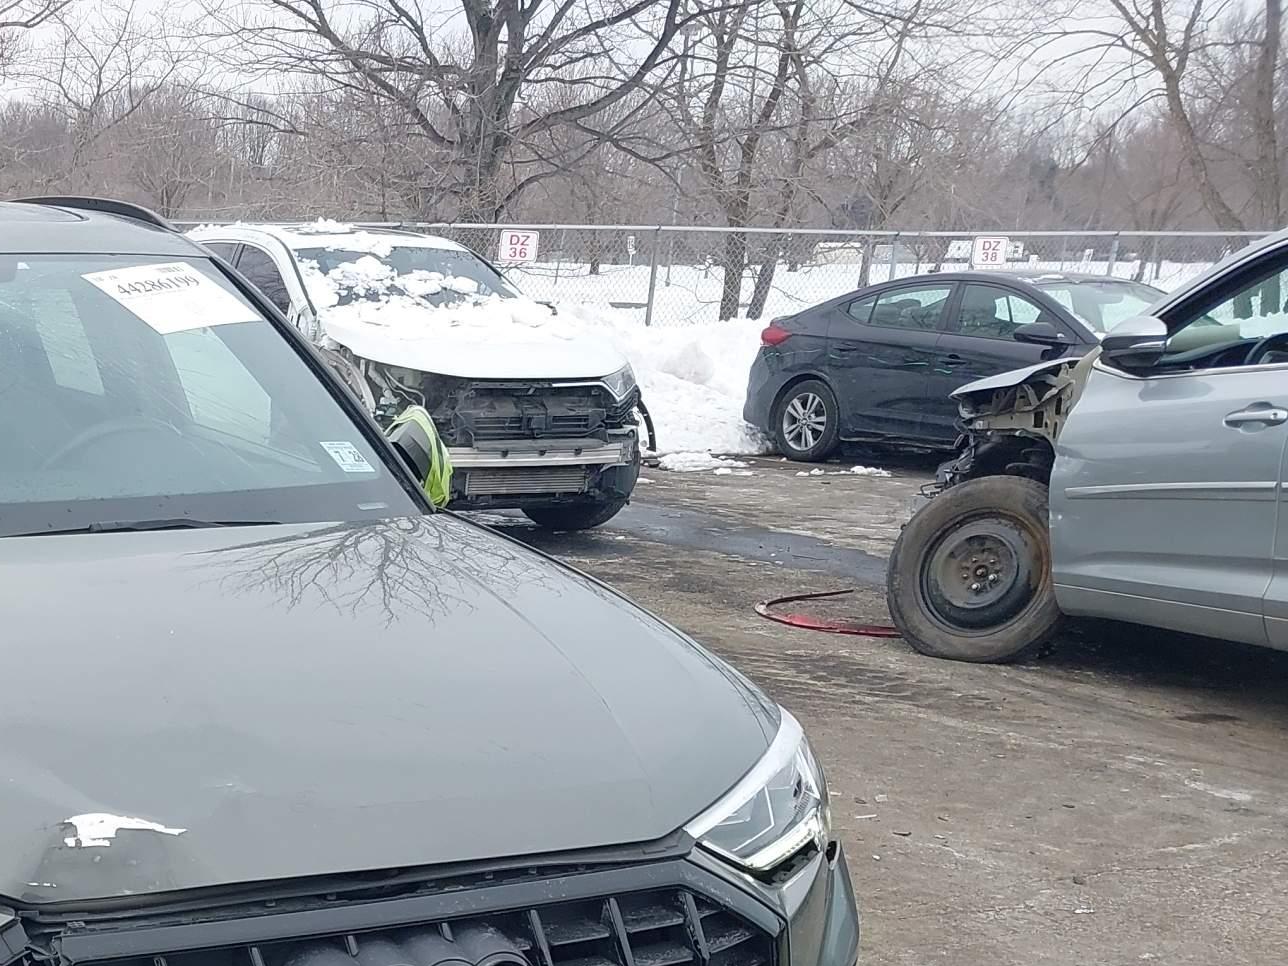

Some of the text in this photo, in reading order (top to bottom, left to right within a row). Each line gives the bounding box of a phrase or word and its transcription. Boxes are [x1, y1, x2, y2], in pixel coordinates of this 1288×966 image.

[509, 234, 531, 246] DZ
[982, 240, 1001, 251] DZ
[509, 247, 527, 258] 36
[981, 251, 997, 262] 38
[117, 274, 200, 295] 44286199
